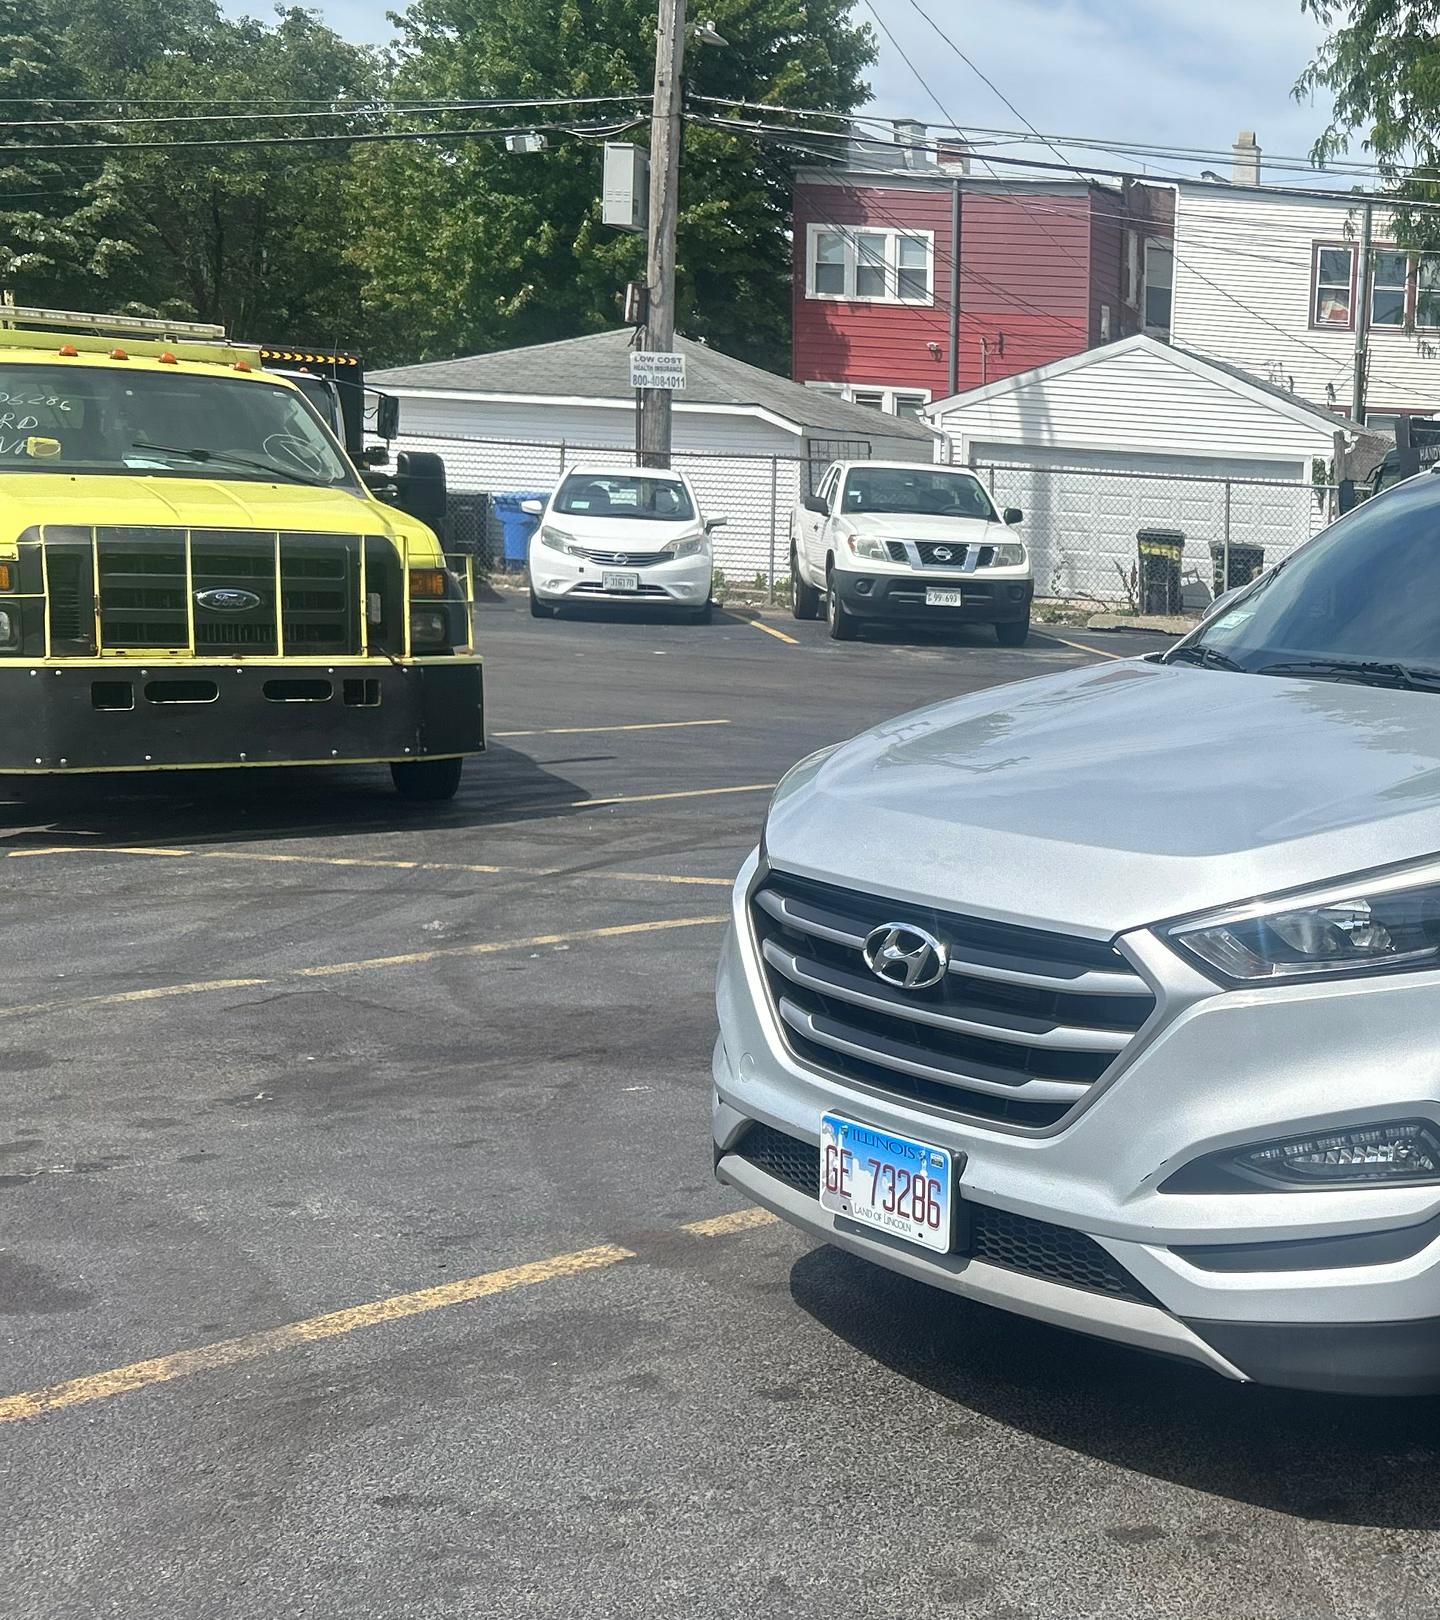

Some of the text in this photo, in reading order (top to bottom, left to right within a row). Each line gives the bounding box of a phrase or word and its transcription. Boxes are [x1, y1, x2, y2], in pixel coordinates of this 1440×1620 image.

[632, 374, 685, 388] 800-408-1011
[654, 365, 683, 373] INSURANCE
[852, 1128, 916, 1160] ILLINOIS
[825, 1144, 941, 1229] GE 73286
[854, 1203, 873, 1219] LAND
[883, 1214, 912, 1233] LINCOLN
